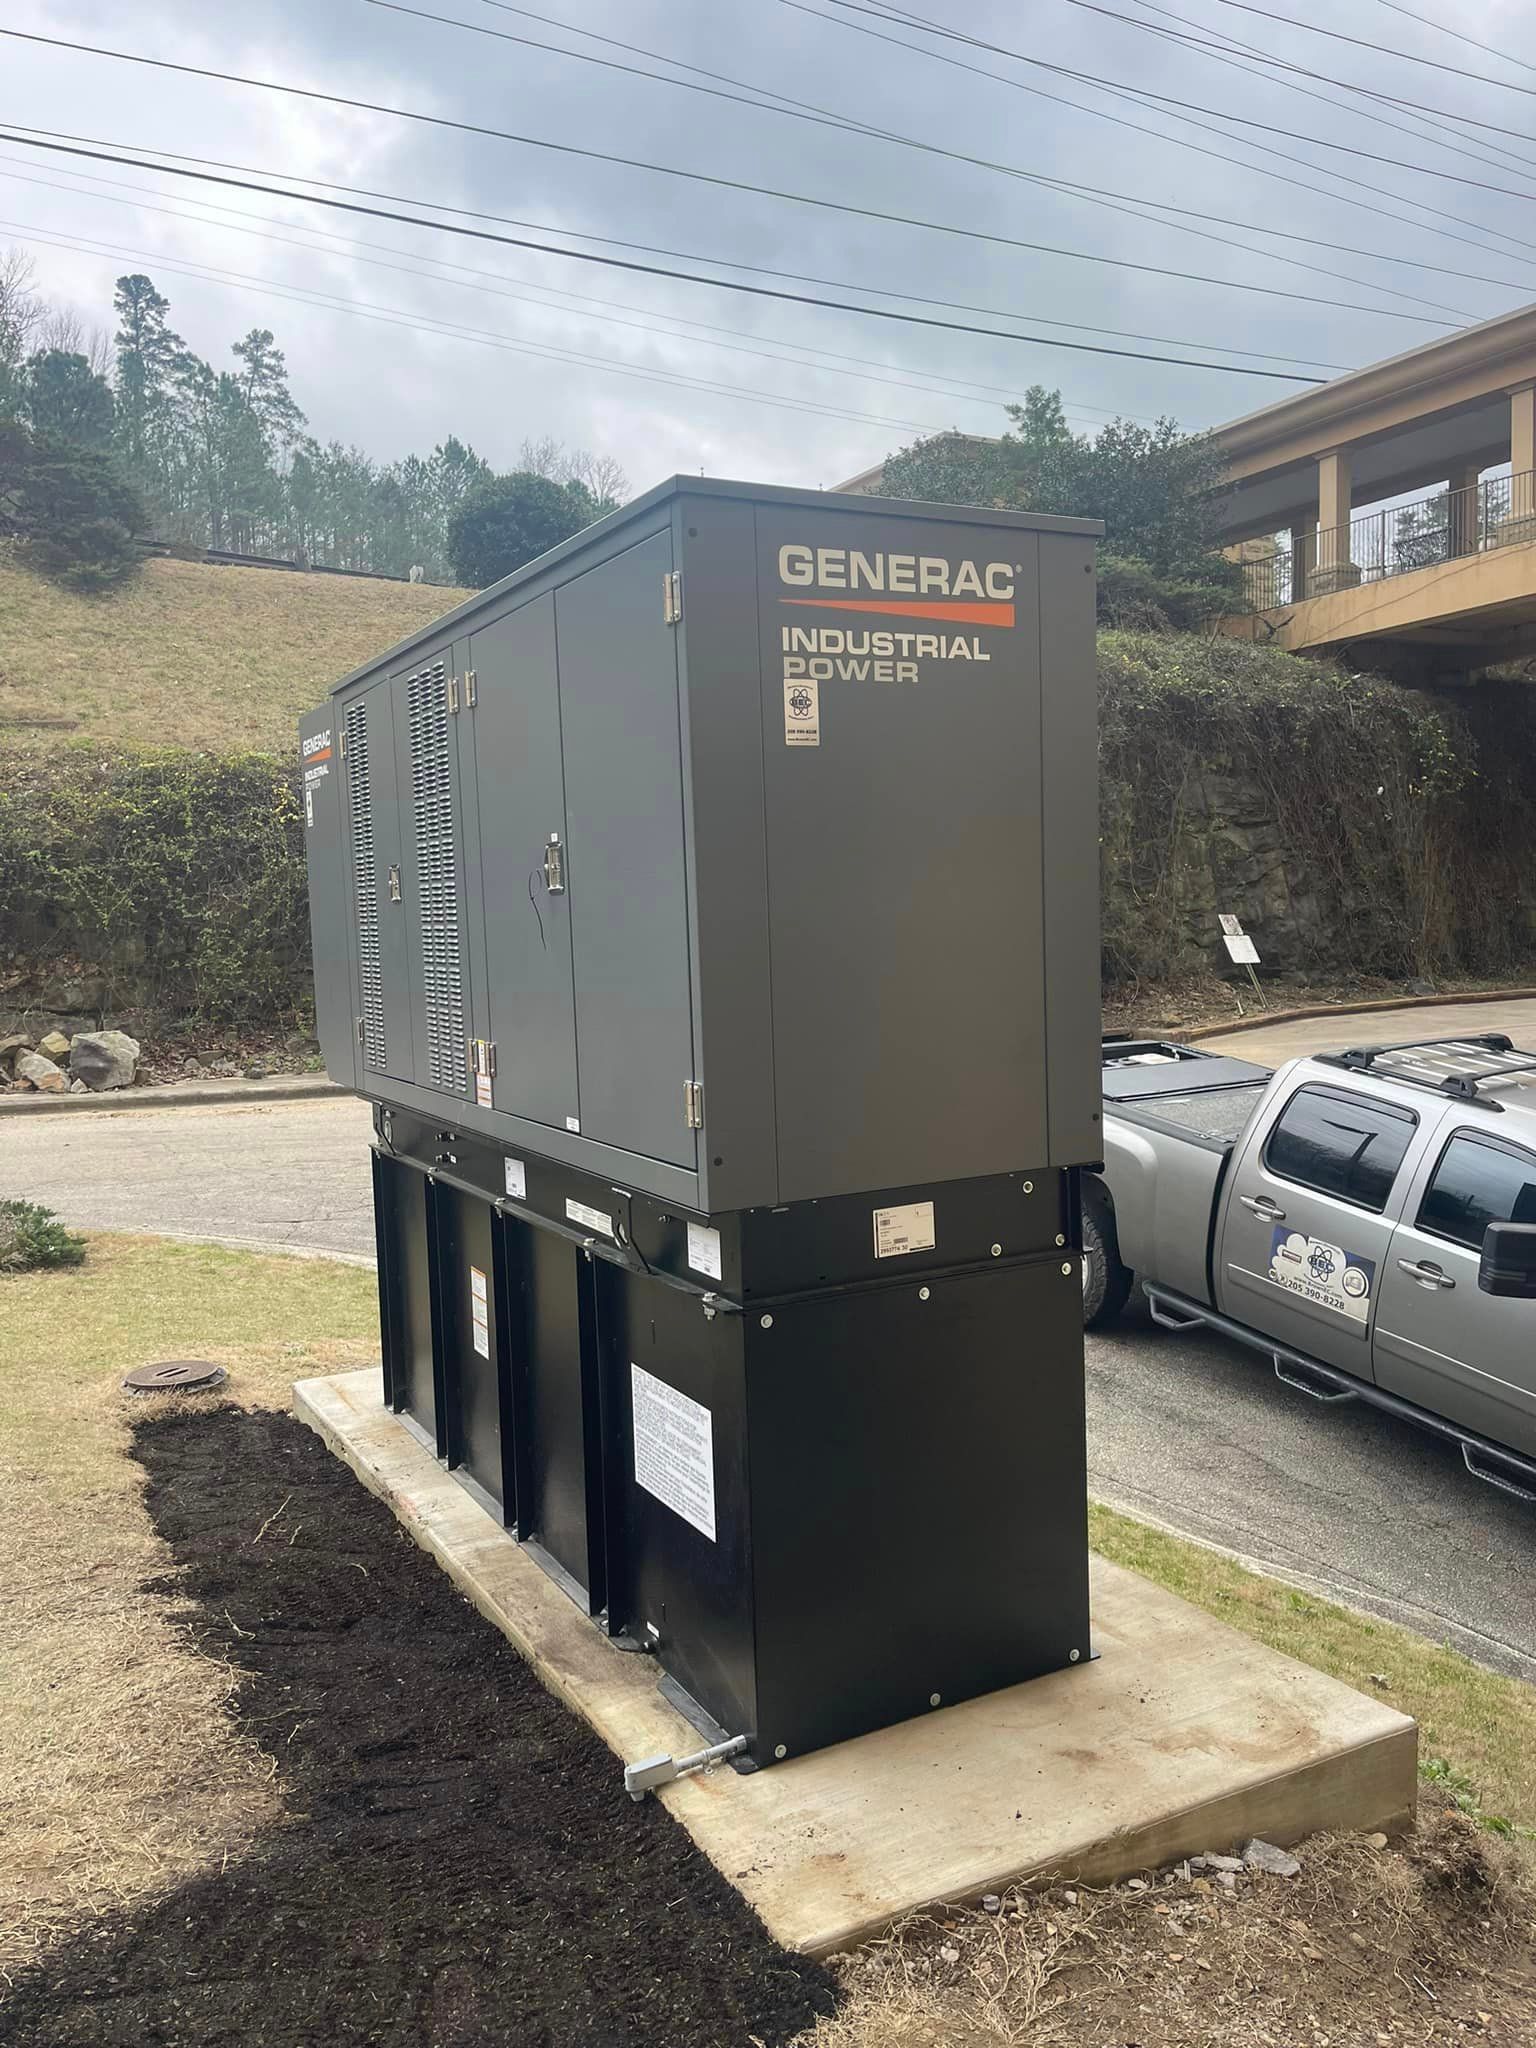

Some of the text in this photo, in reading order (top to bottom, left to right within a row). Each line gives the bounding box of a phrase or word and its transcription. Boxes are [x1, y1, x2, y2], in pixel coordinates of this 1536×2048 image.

[778, 544, 1015, 600] GENERAC
[782, 626, 991, 661] INDUSTRIAL
[783, 656, 919, 683] POWER
[1310, 1255, 1335, 1272] BEC
[1288, 1280, 1303, 1292] 205
[1305, 1287, 1345, 1310] 390-8228
